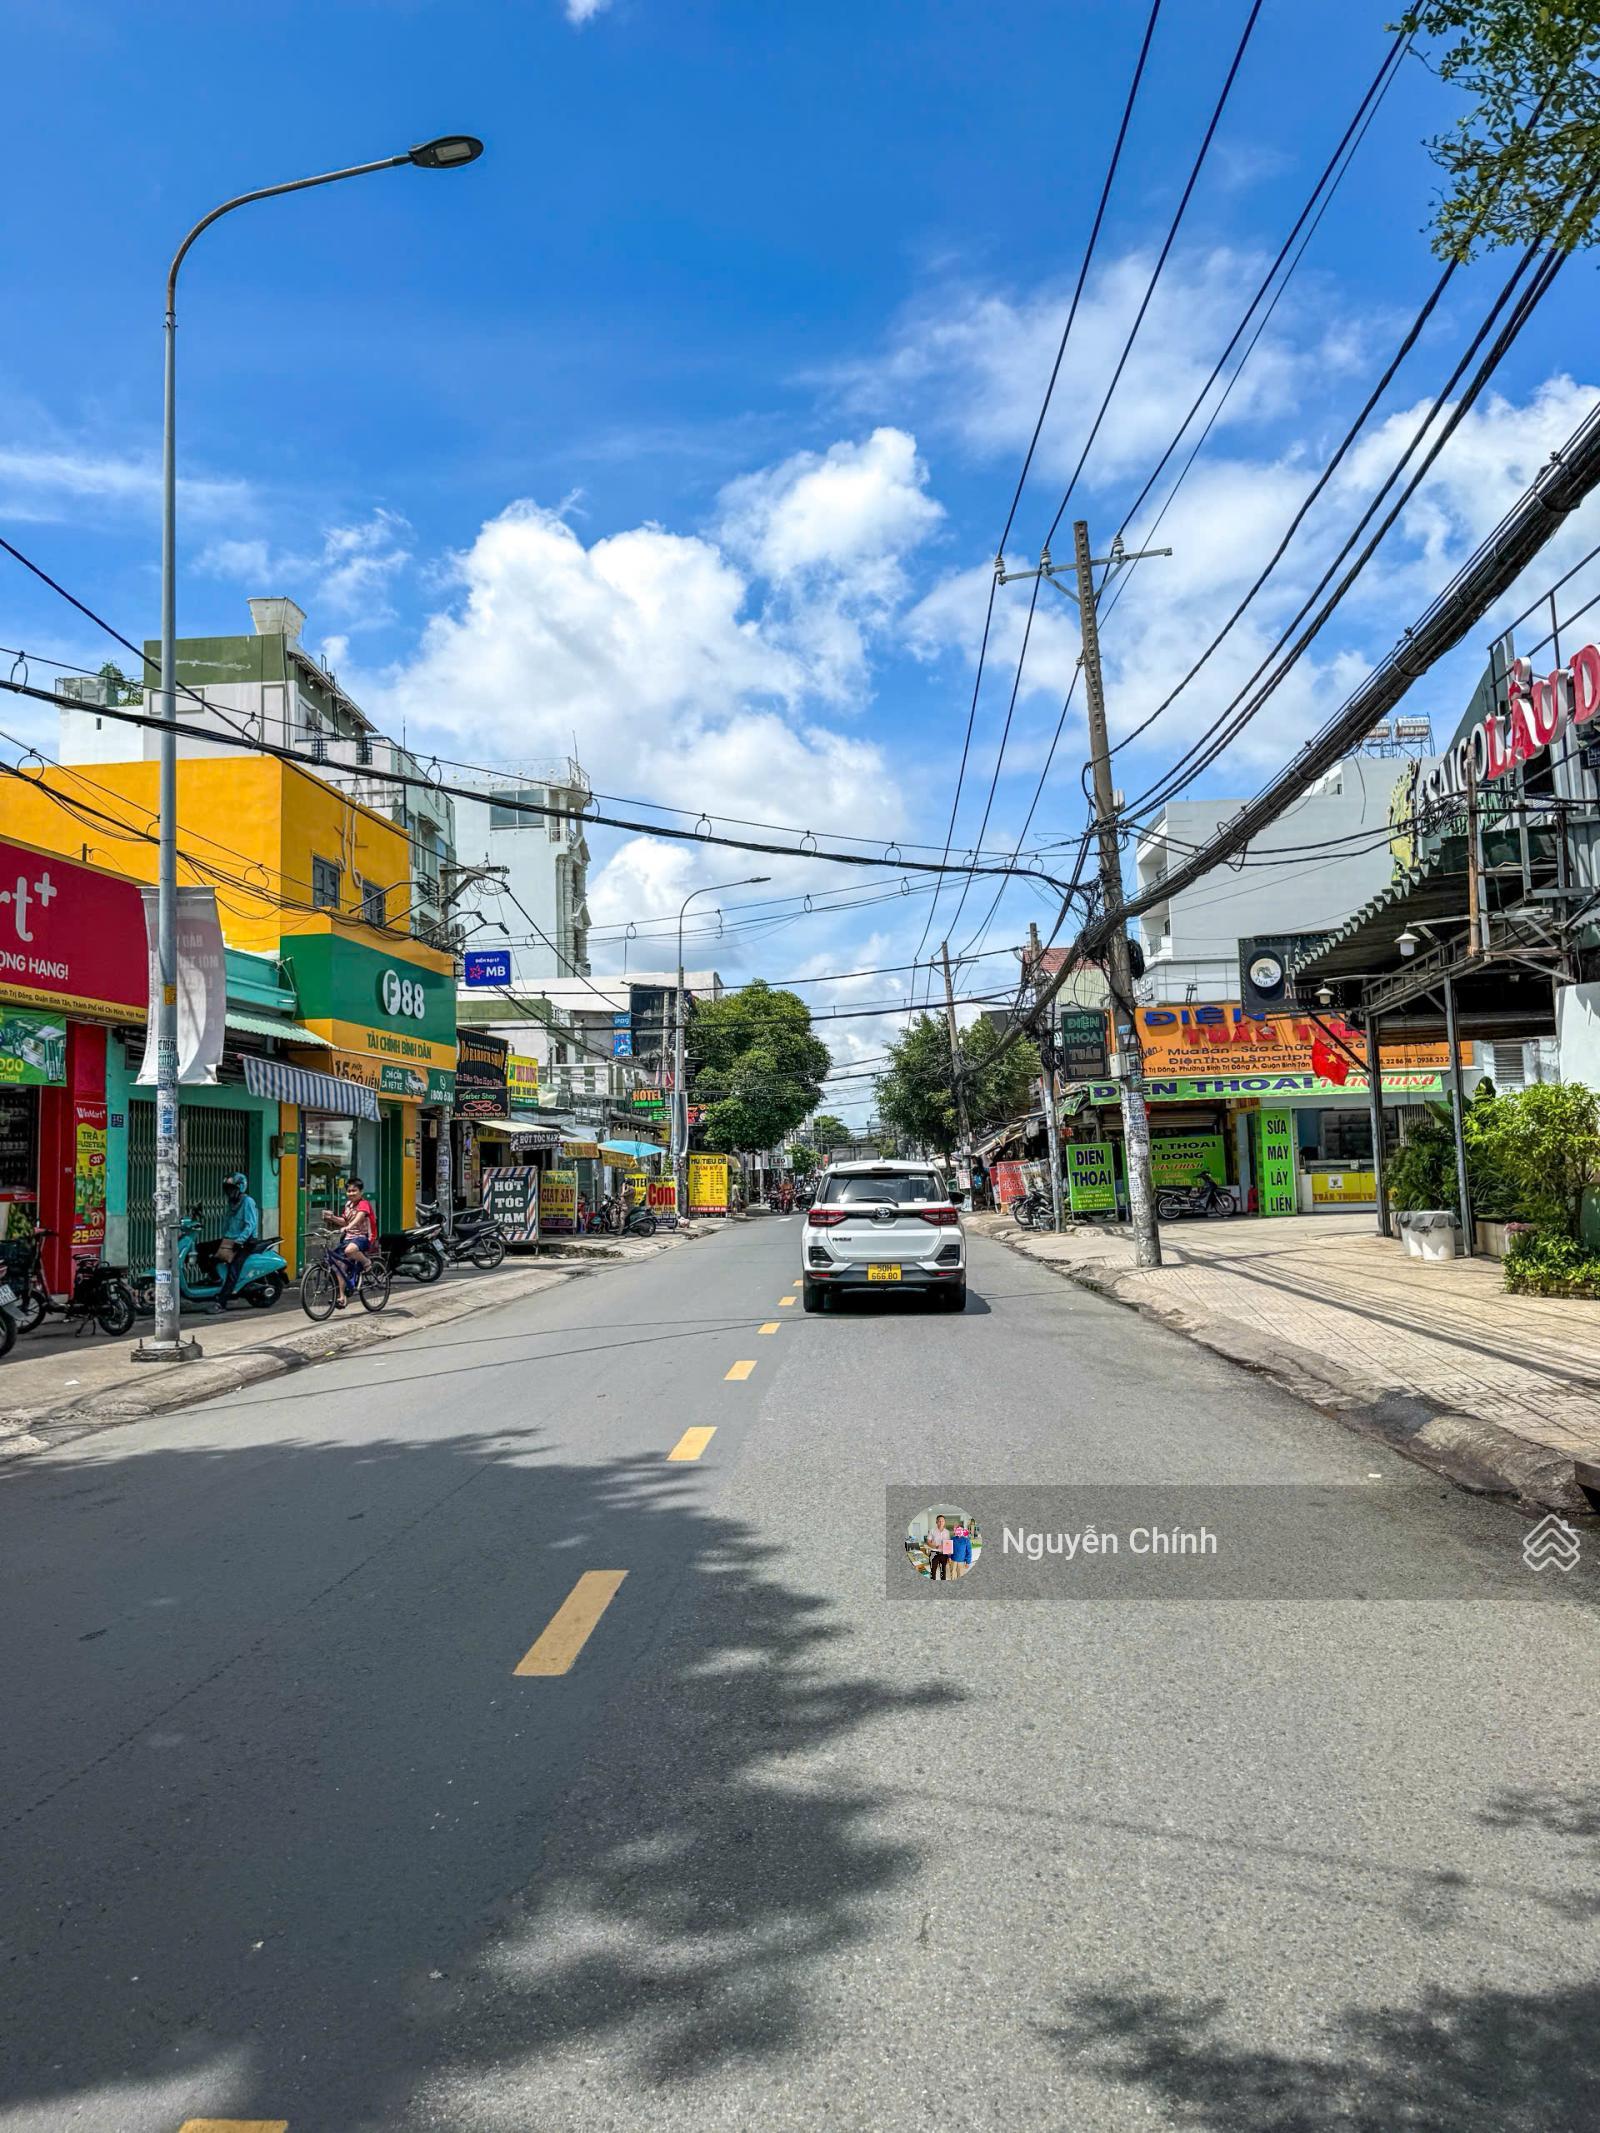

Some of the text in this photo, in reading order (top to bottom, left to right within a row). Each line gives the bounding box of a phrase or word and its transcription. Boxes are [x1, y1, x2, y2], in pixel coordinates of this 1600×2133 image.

[29, 957, 69, 981] HẠNG!
[486, 965, 506, 977] MB
[1067, 1015, 1100, 1030] ĐIỆN
[367, 1030, 432, 1059] TÀI CHÍNH BÌNH DÂN
[1065, 1031, 1104, 1044] THOẠI
[1190, 1077, 1314, 1094] THOẠI
[481, 1093, 497, 1101] Shop
[632, 1089, 663, 1101] HOTEL
[1267, 1115, 1287, 1135] SỬA
[1076, 1147, 1104, 1168] ĐIỆN
[1268, 1142, 1289, 1160] MÁY
[494, 1178, 524, 1191] HỚT
[1072, 1170, 1112, 1189] THOẠI
[494, 1195, 524, 1208] TÓC
[648, 1182, 676, 1206] Cơm
[493, 1212, 525, 1223] NAM
